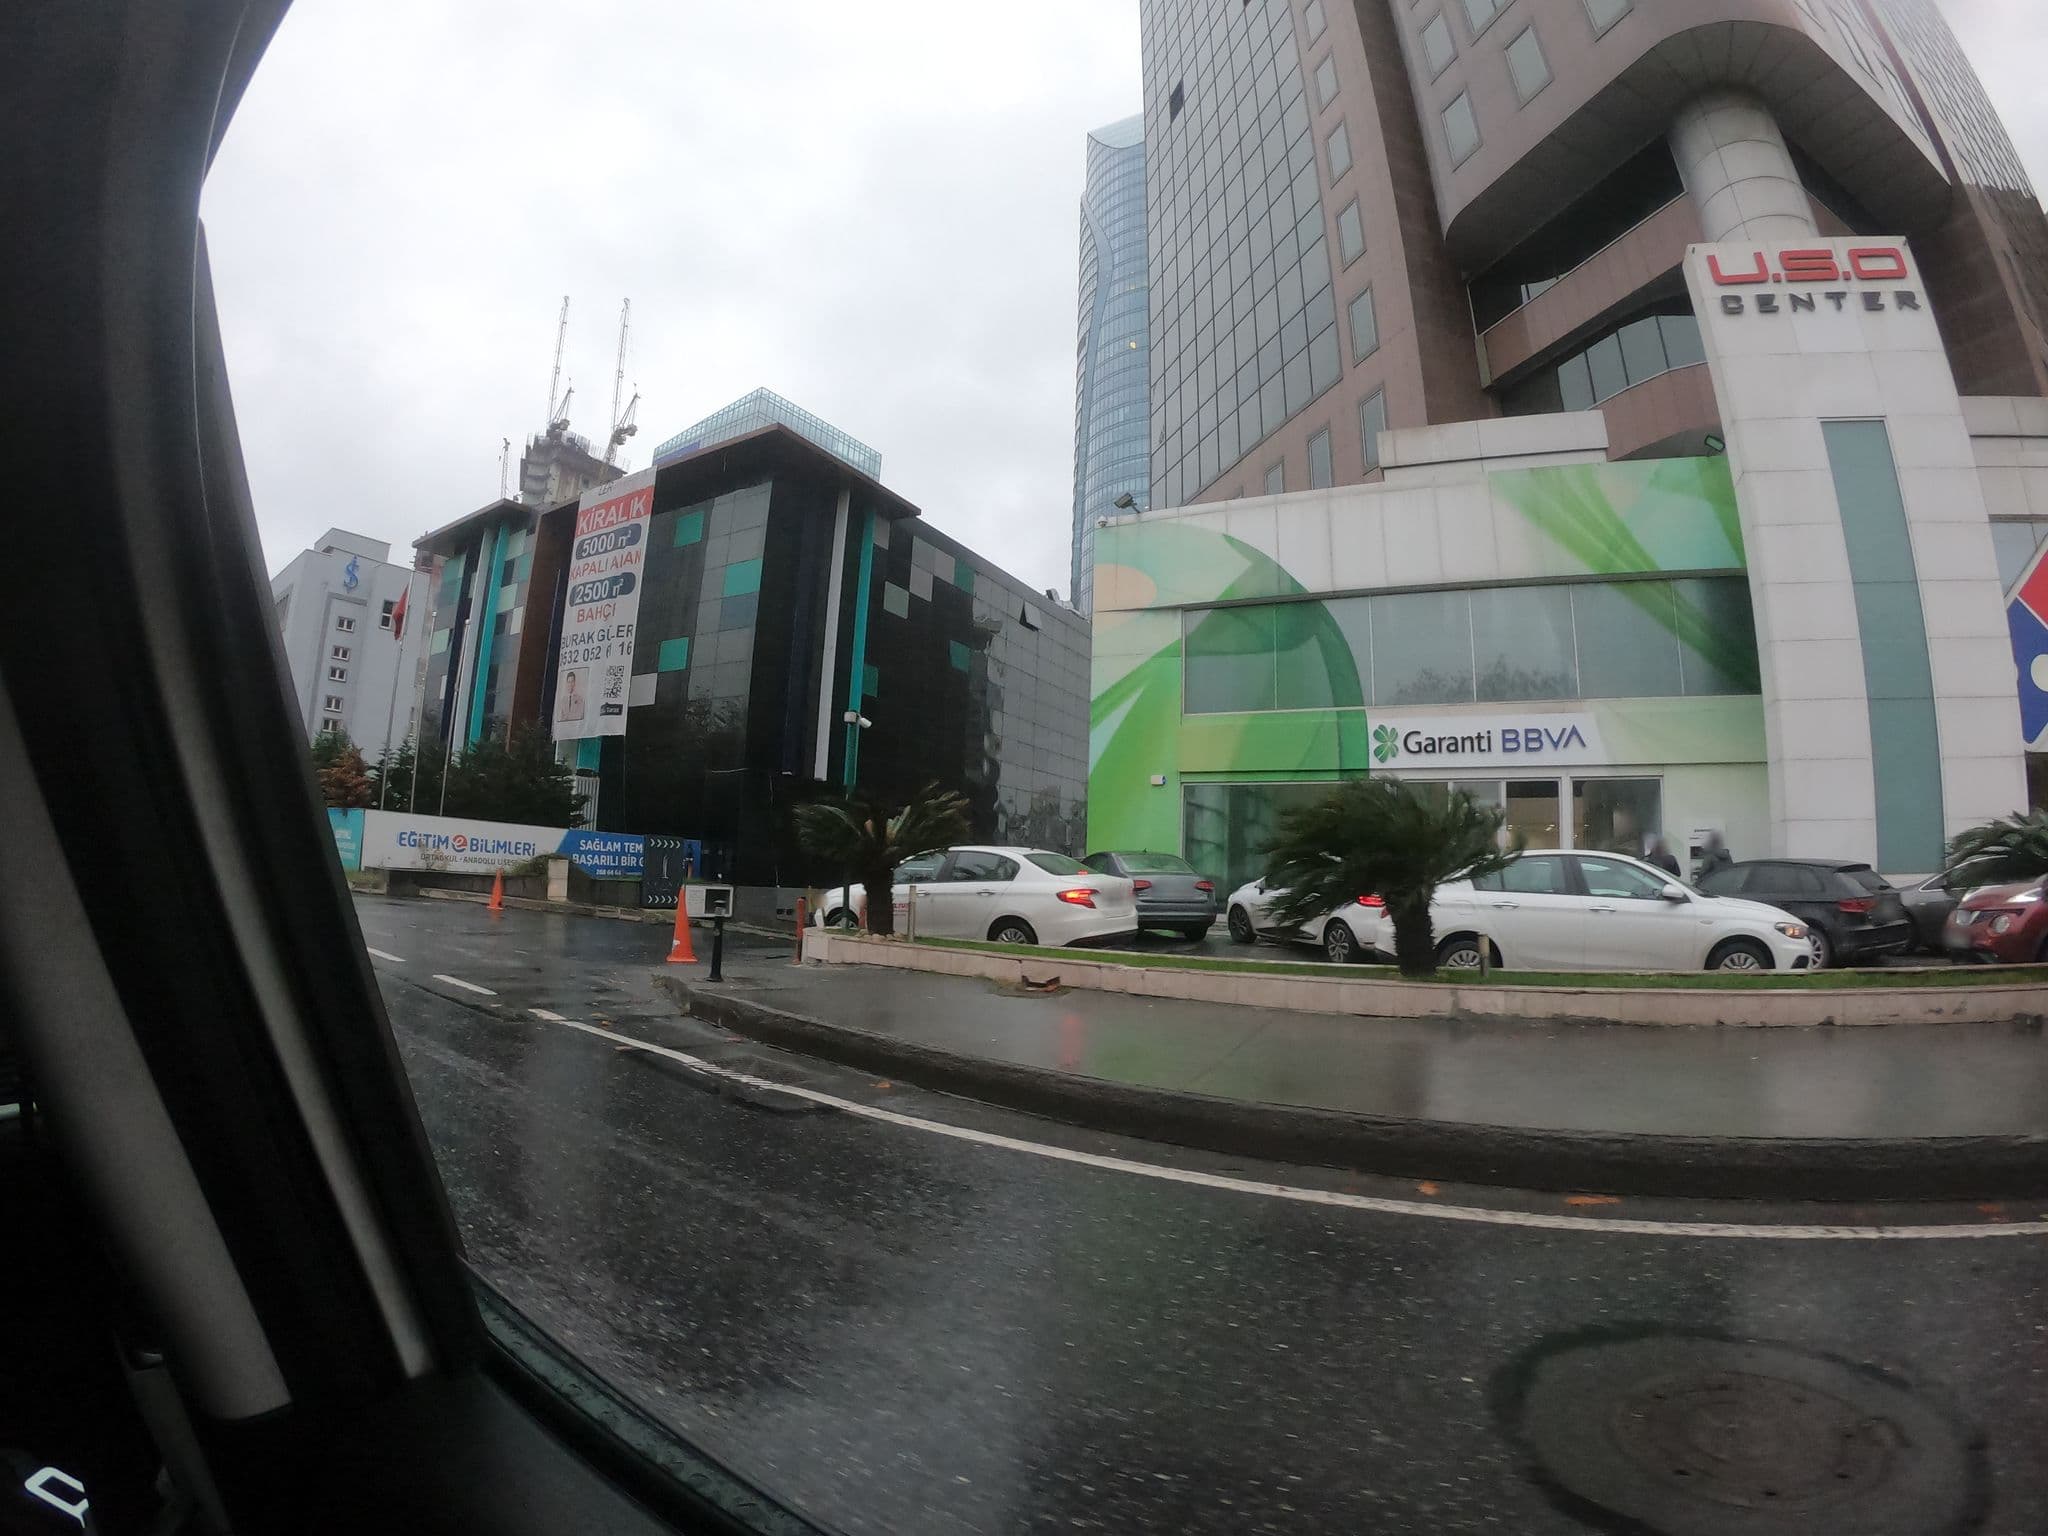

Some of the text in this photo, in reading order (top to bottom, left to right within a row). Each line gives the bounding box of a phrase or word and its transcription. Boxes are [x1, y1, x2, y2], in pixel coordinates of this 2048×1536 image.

[1720, 289, 1921, 315] CENTER
[577, 494, 647, 536] KİRALIK
[581, 532, 615, 557] 5000
[574, 580, 609, 604] 2500
[1403, 724, 1587, 754] Garanti BBVA
[579, 837, 621, 853] SAĞLAM
[572, 853, 619, 867] BAŞARILI
[620, 855, 637, 867] BİR
